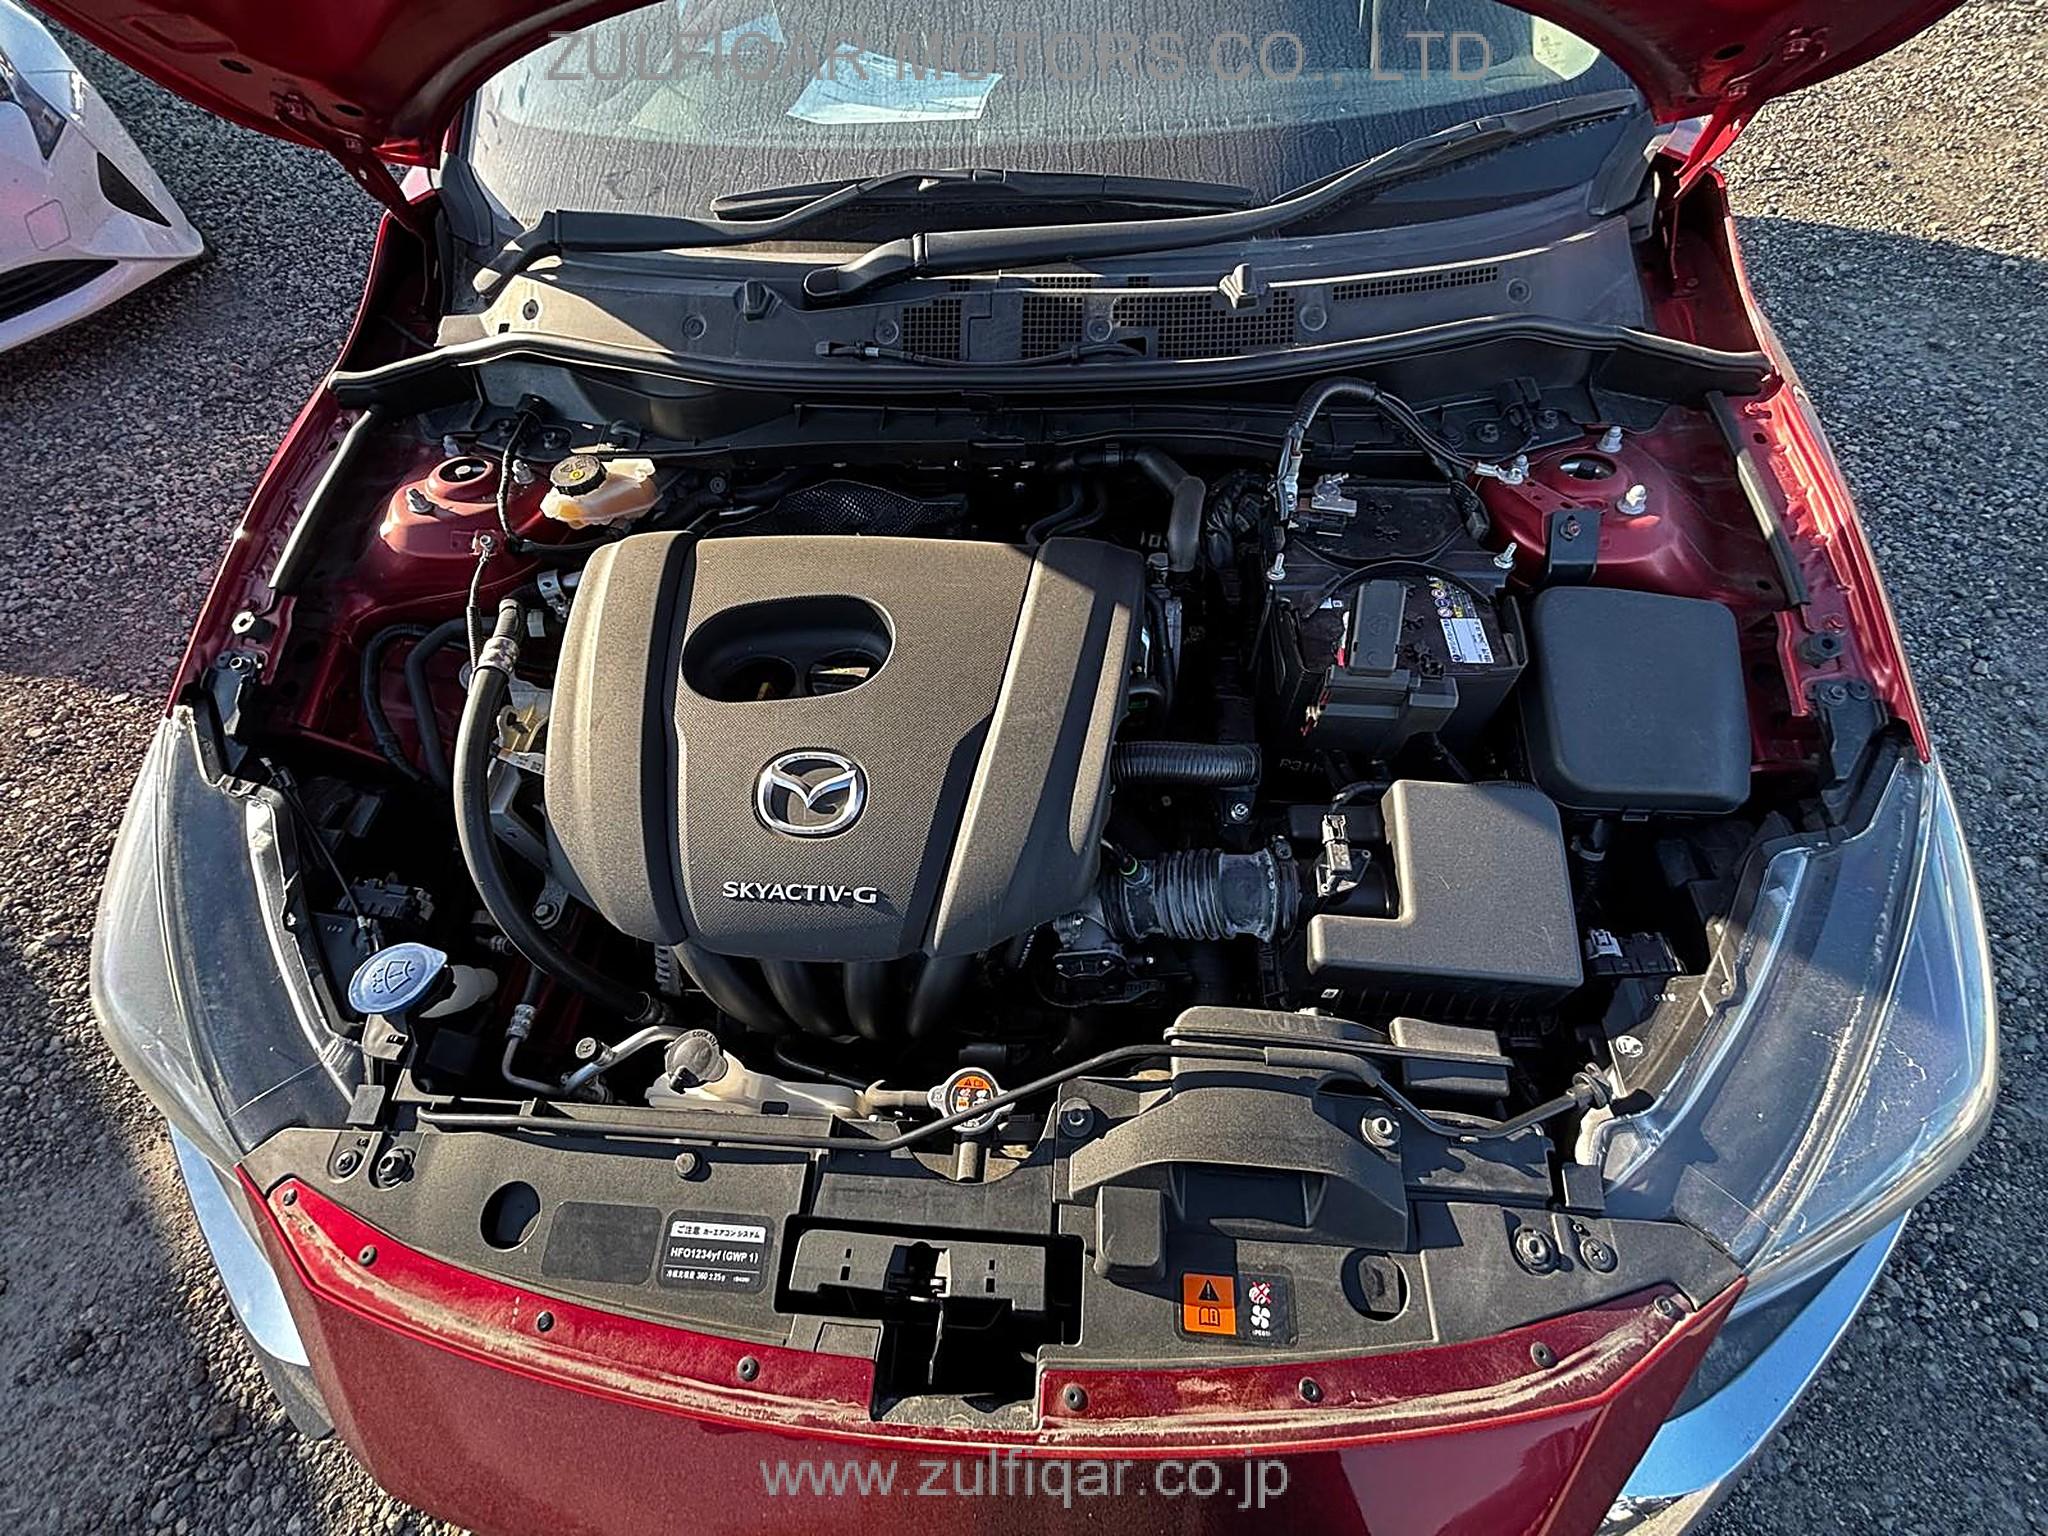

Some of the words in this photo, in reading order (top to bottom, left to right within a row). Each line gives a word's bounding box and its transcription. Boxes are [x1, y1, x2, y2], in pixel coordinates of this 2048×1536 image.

[722, 881, 878, 904] SKYACTIV-G
[670, 1247, 722, 1263] HFO1234yf
[722, 1250, 748, 1262] (GWP
[749, 1252, 759, 1264] 1)
